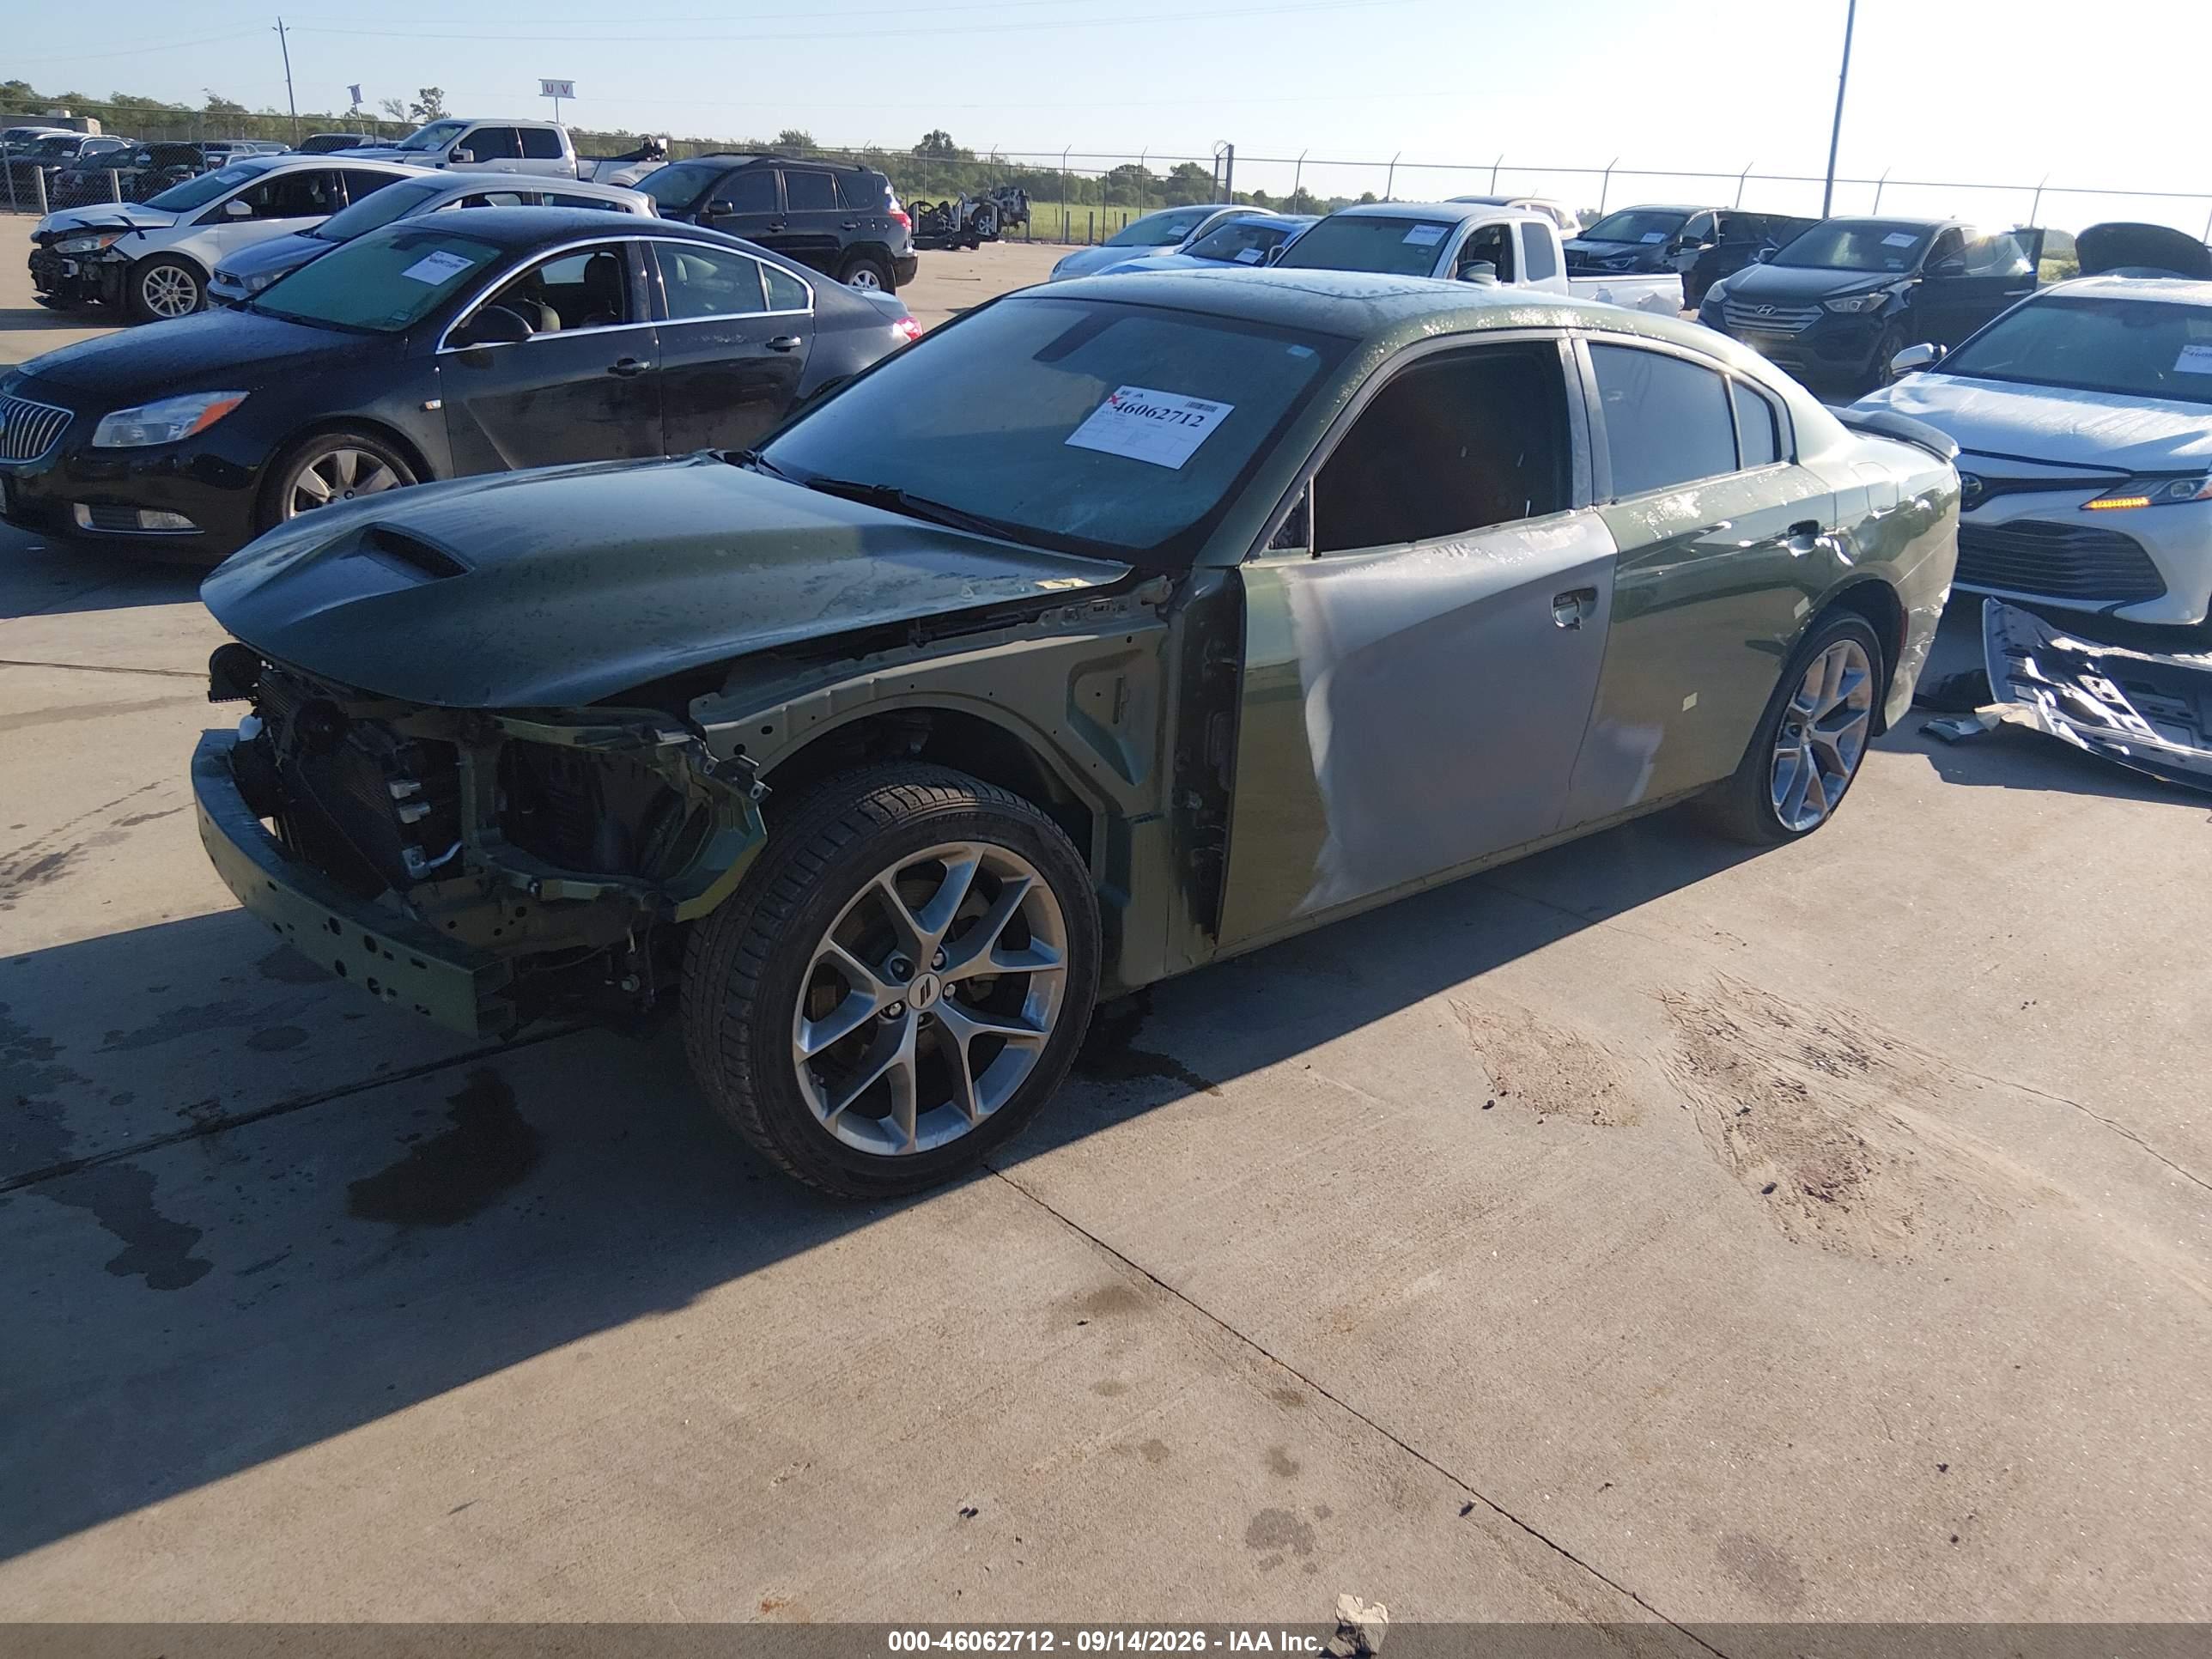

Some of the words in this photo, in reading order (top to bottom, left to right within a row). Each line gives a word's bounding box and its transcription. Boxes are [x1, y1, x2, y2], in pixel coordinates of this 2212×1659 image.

[545, 83, 554, 94] U
[562, 83, 569, 94] V
[1113, 401, 1205, 428] 46062712
